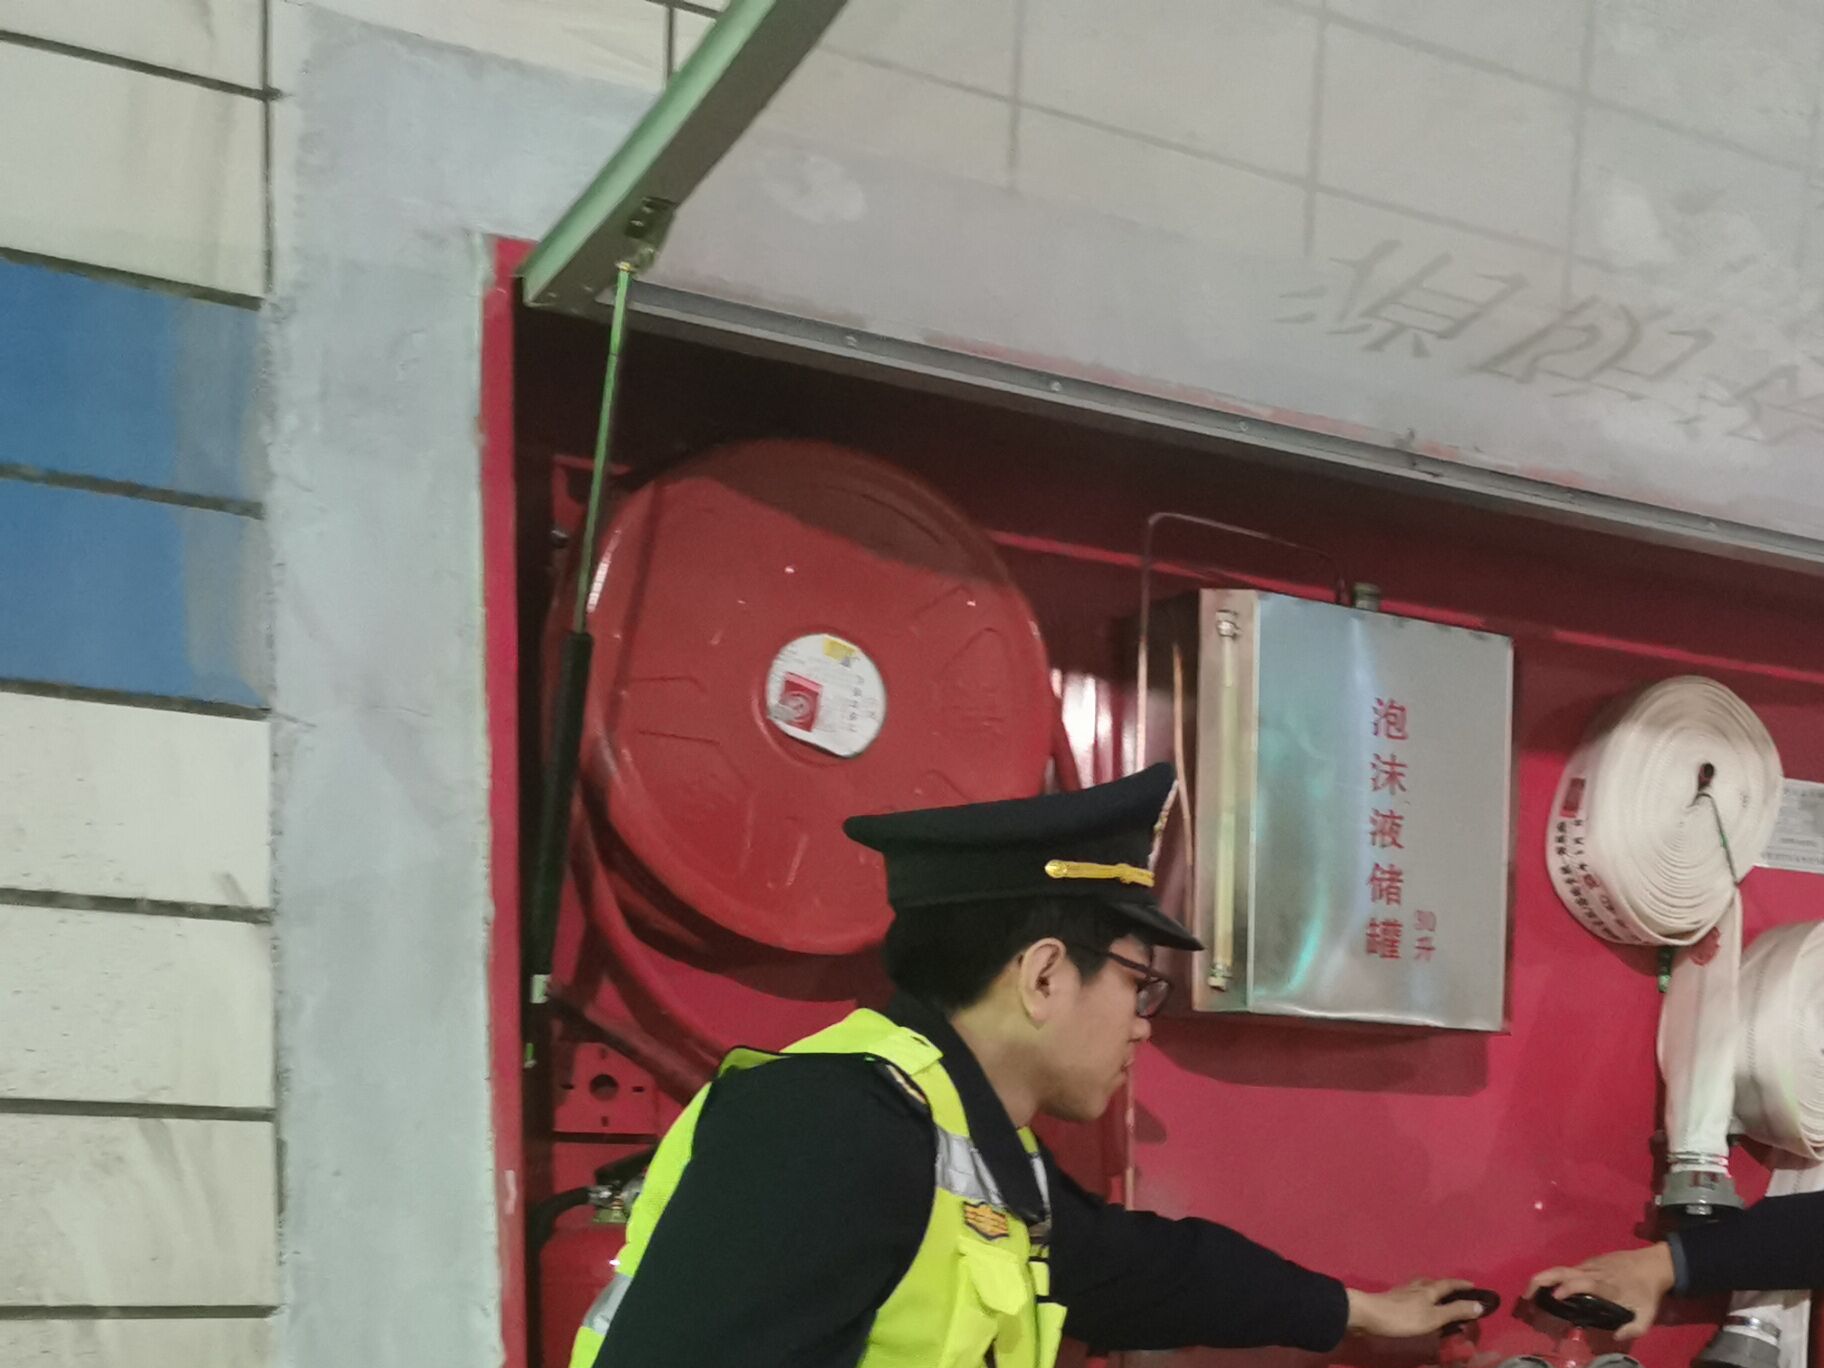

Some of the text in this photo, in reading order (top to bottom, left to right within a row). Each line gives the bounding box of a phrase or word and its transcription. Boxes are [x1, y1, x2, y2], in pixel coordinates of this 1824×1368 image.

[1365, 697, 1408, 960] 泡沫液储罐
